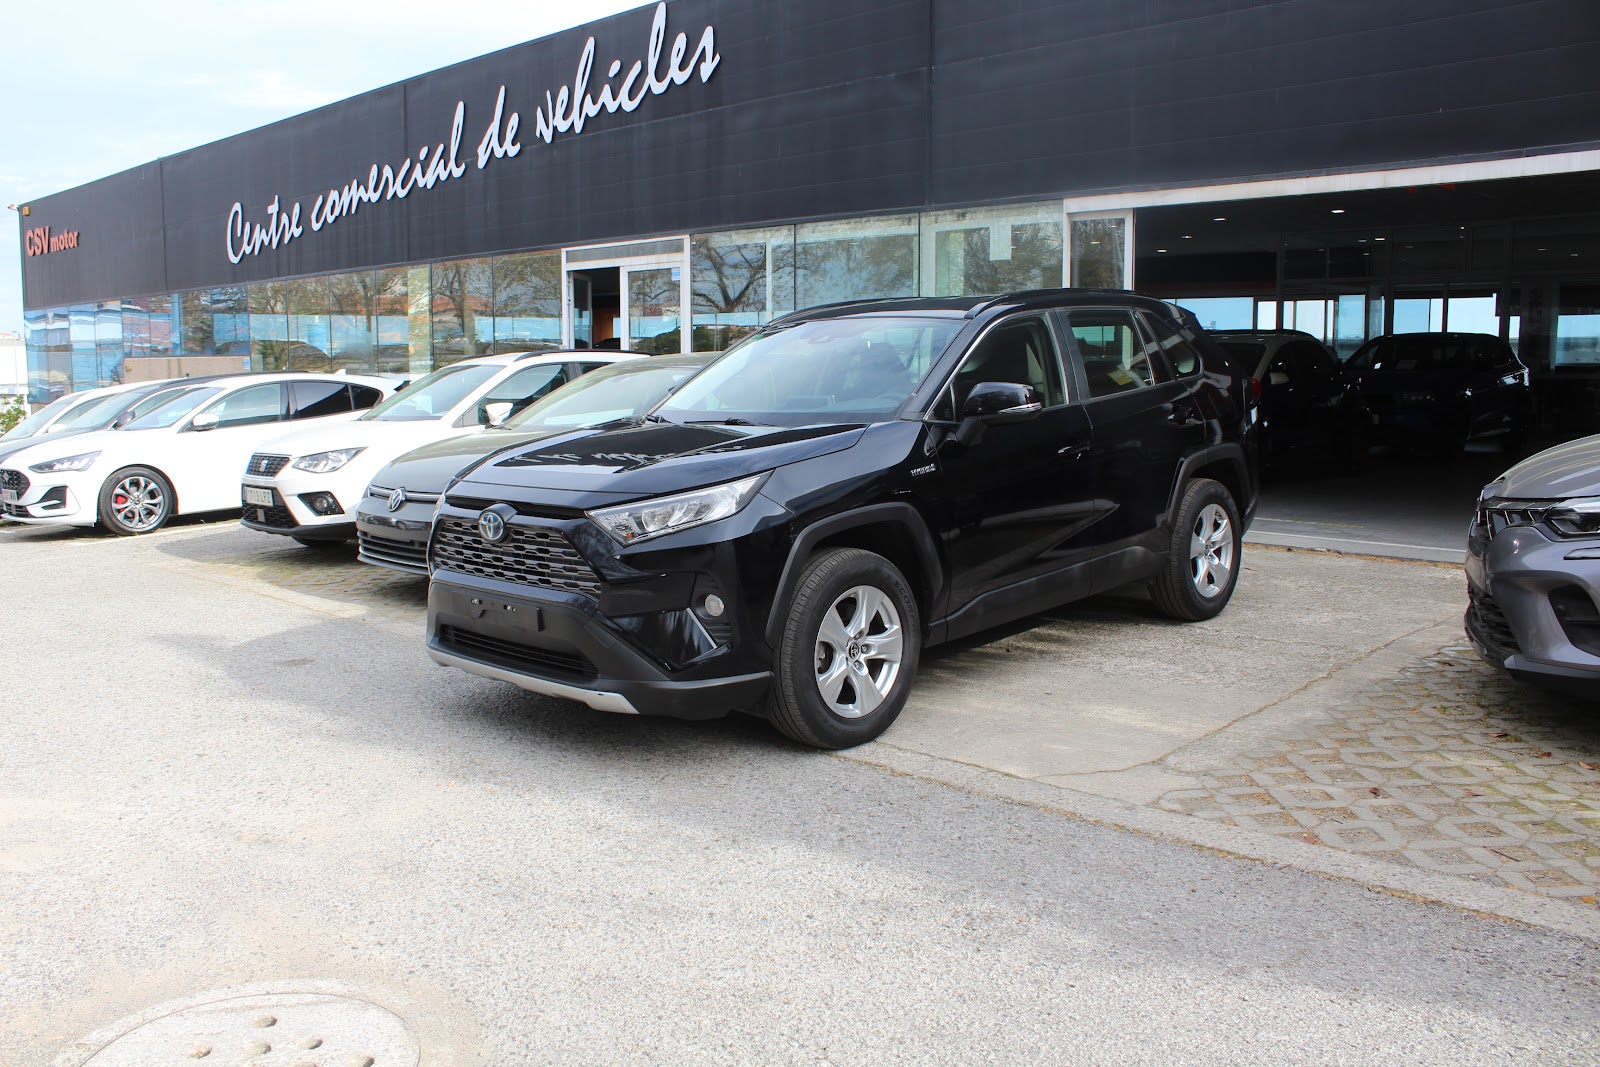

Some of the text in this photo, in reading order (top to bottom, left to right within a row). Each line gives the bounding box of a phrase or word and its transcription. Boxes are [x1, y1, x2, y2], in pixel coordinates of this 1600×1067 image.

[227, 2, 720, 264] Centre comercial de vehicles
[26, 225, 79, 257] CSV motor
